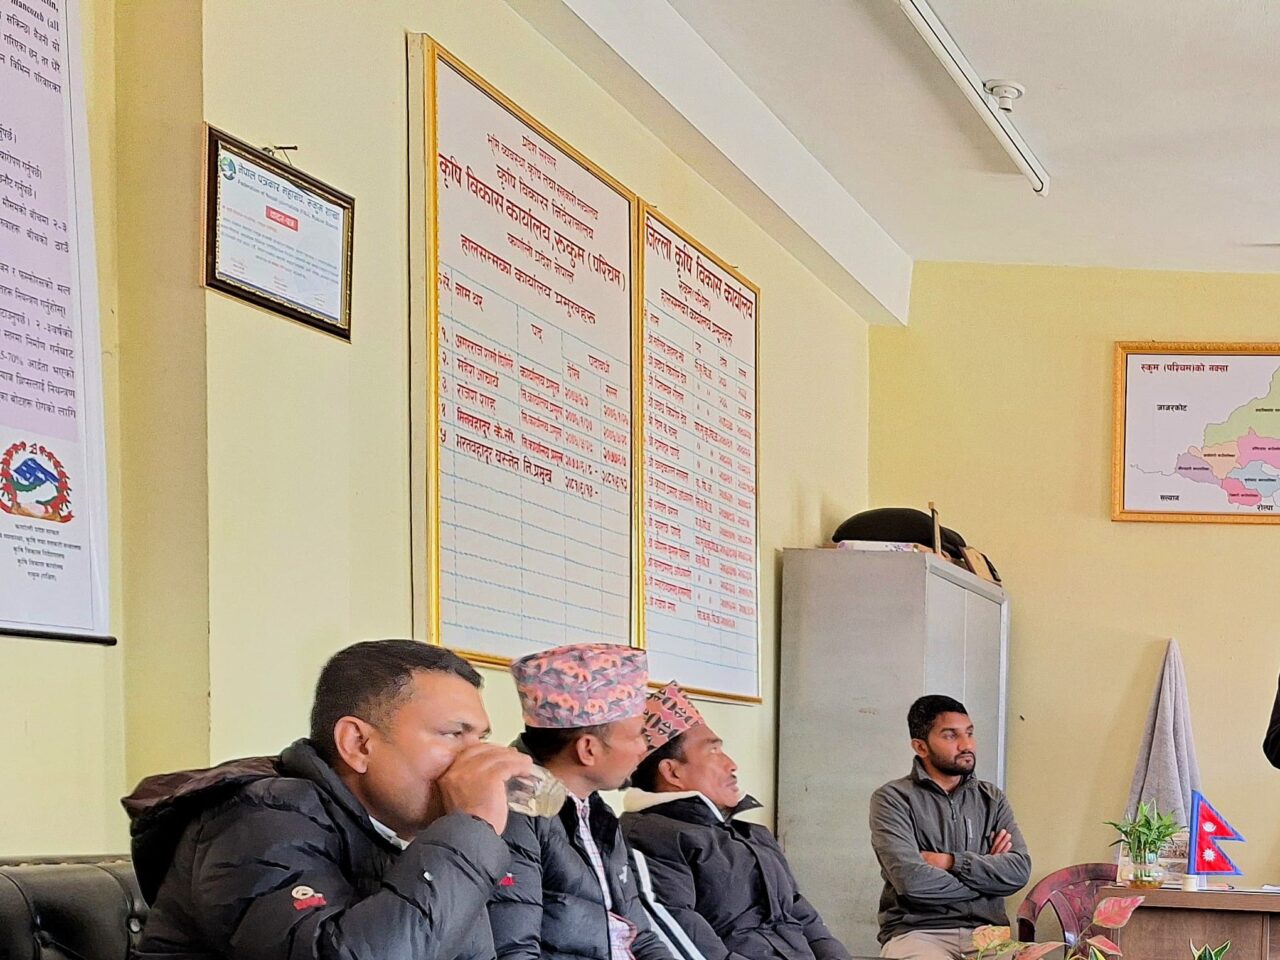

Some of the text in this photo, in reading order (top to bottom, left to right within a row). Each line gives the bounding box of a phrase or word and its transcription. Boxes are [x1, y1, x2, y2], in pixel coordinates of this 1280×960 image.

[439, 153, 462, 188] कृषि
[466, 166, 504, 213] विकास
[505, 199, 551, 242] कार्यालय
[496, 164, 516, 190] कृषि
[519, 179, 548, 210] विकास
[514, 266, 552, 298] कार्यालय
[645, 215, 753, 320] जिल्ला कृषि विकास कार्यालय
[455, 282, 471, 302] नाम
[1157, 403, 1188, 412] जाजरकोट
